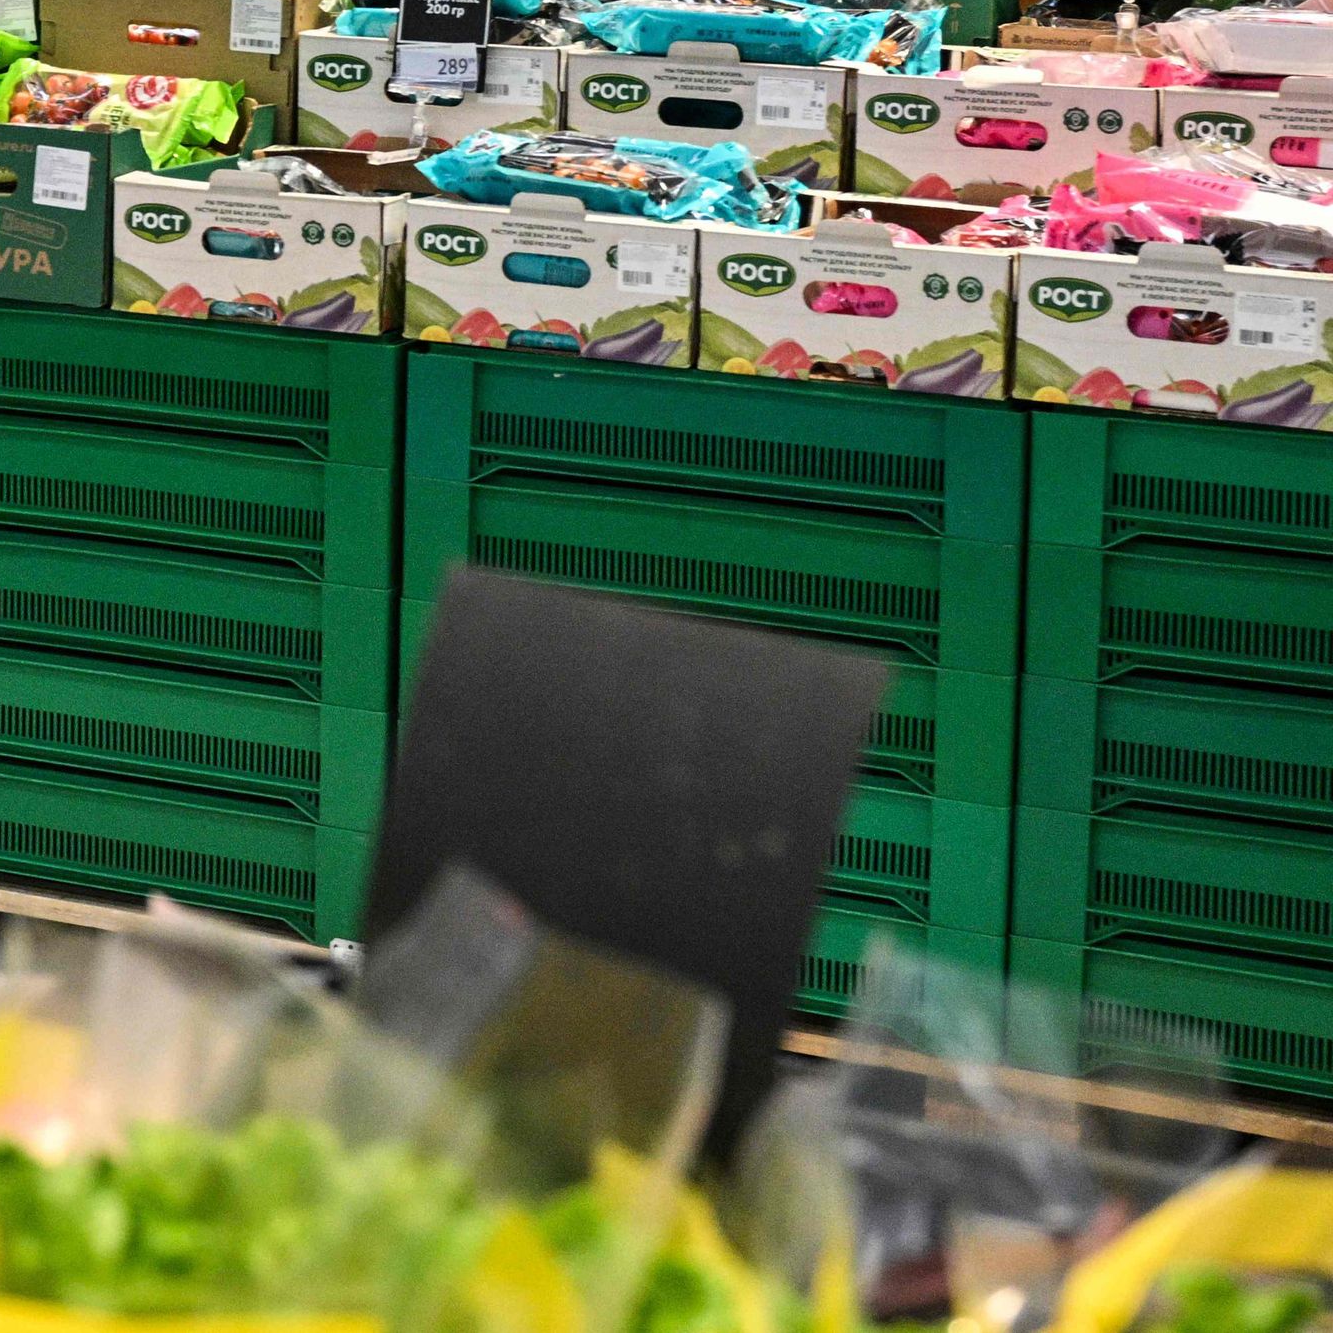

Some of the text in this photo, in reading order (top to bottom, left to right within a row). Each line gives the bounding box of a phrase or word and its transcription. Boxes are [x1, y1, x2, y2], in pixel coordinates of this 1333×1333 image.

[425, 3, 466, 19] 200 гр
[313, 61, 366, 80] РОСТ
[437, 58, 469, 76] 289
[587, 81, 644, 102] РОСТ
[872, 101, 933, 122] РОСТ
[1183, 119, 1247, 142] РОСТ
[131, 210, 186, 232] РОСТ
[422, 231, 481, 254] РОСТ
[725, 261, 788, 285] РОСТ
[1037, 285, 1104, 310] РОСТ
